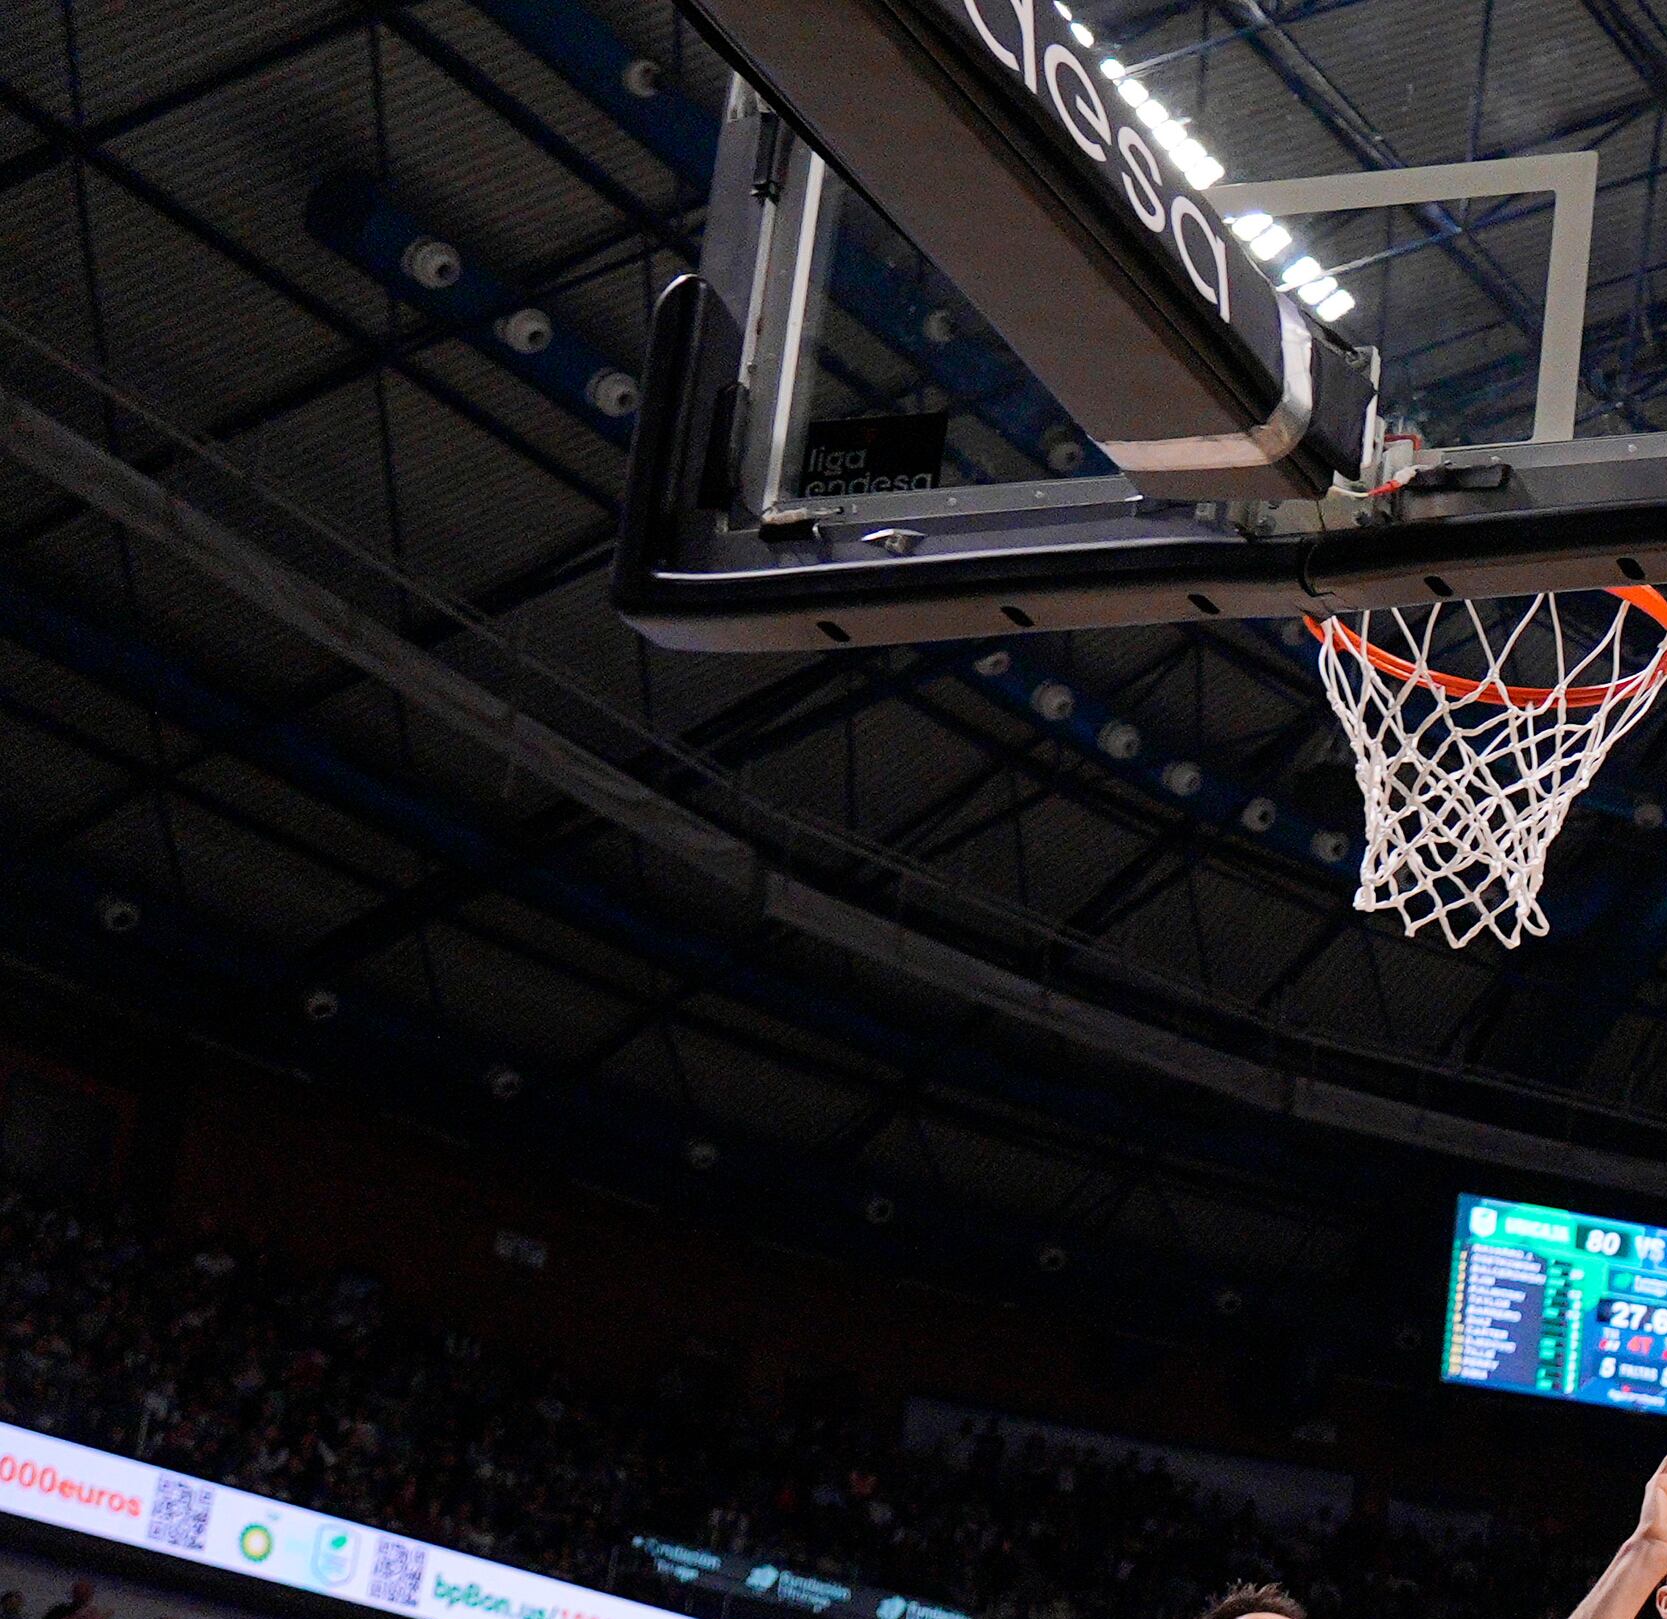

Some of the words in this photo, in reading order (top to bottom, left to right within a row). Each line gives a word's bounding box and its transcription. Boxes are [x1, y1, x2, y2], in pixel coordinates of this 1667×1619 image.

[807, 446, 867, 476] liga
[1585, 1228, 1621, 1256] 80
[1634, 1234, 1666, 1263] VS
